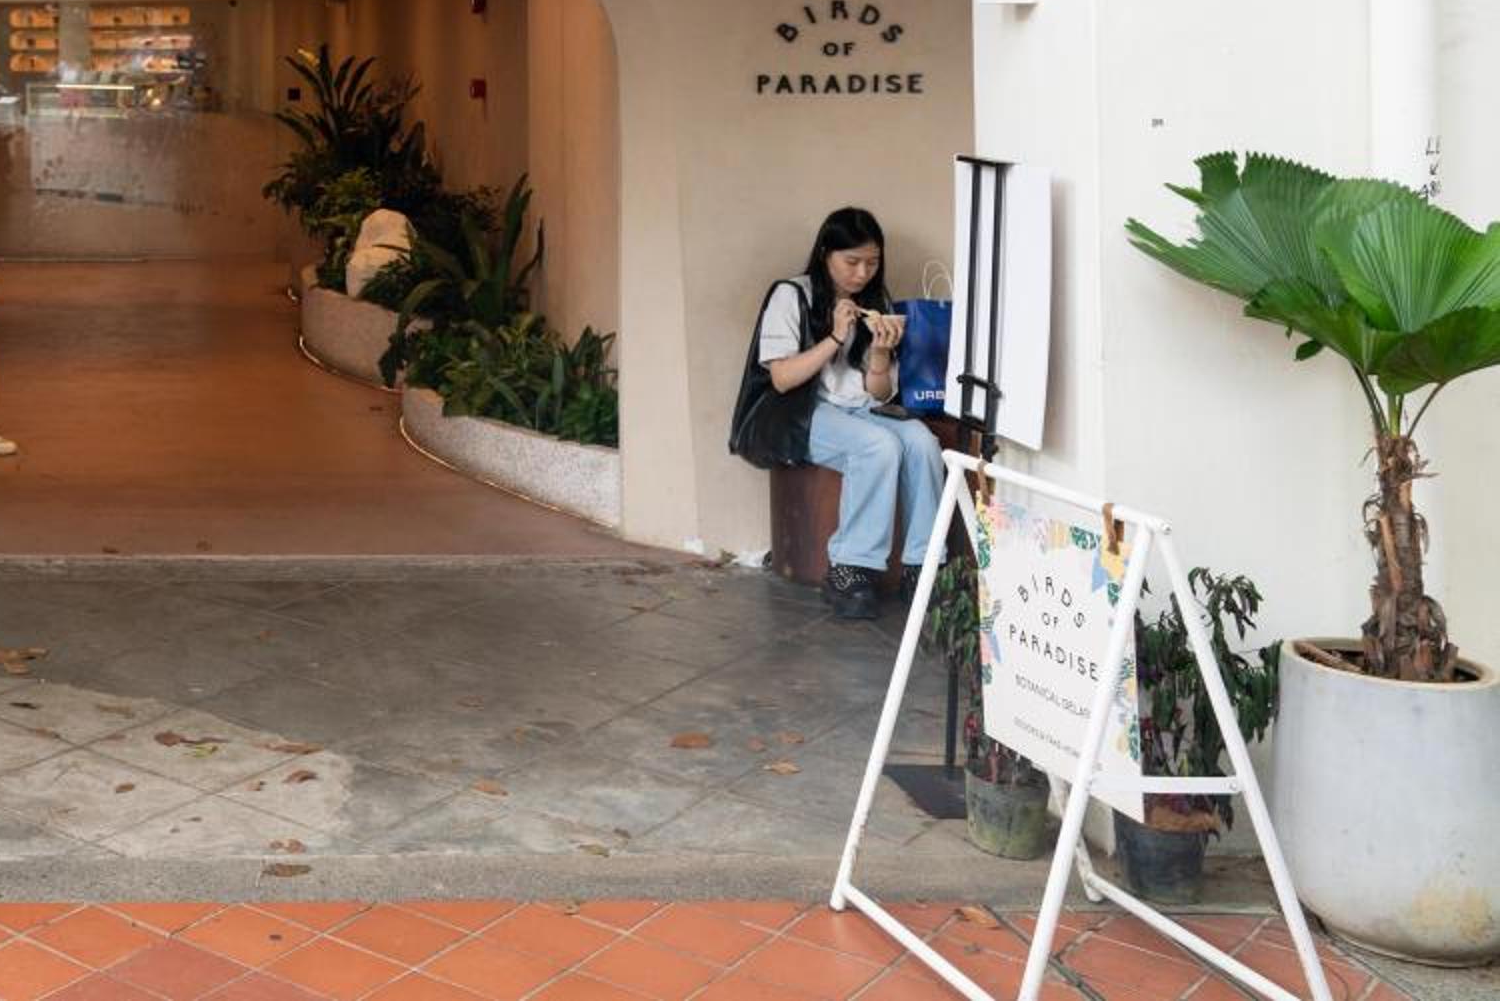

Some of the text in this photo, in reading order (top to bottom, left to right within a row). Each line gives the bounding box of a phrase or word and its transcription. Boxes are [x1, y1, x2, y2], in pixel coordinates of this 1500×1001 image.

[822, 41, 857, 57] OF
[756, 73, 924, 94] PARADISE
[1017, 574, 1086, 629] BIRDS
[1041, 611, 1059, 629] OF
[1009, 623, 1099, 682] PARADISE
